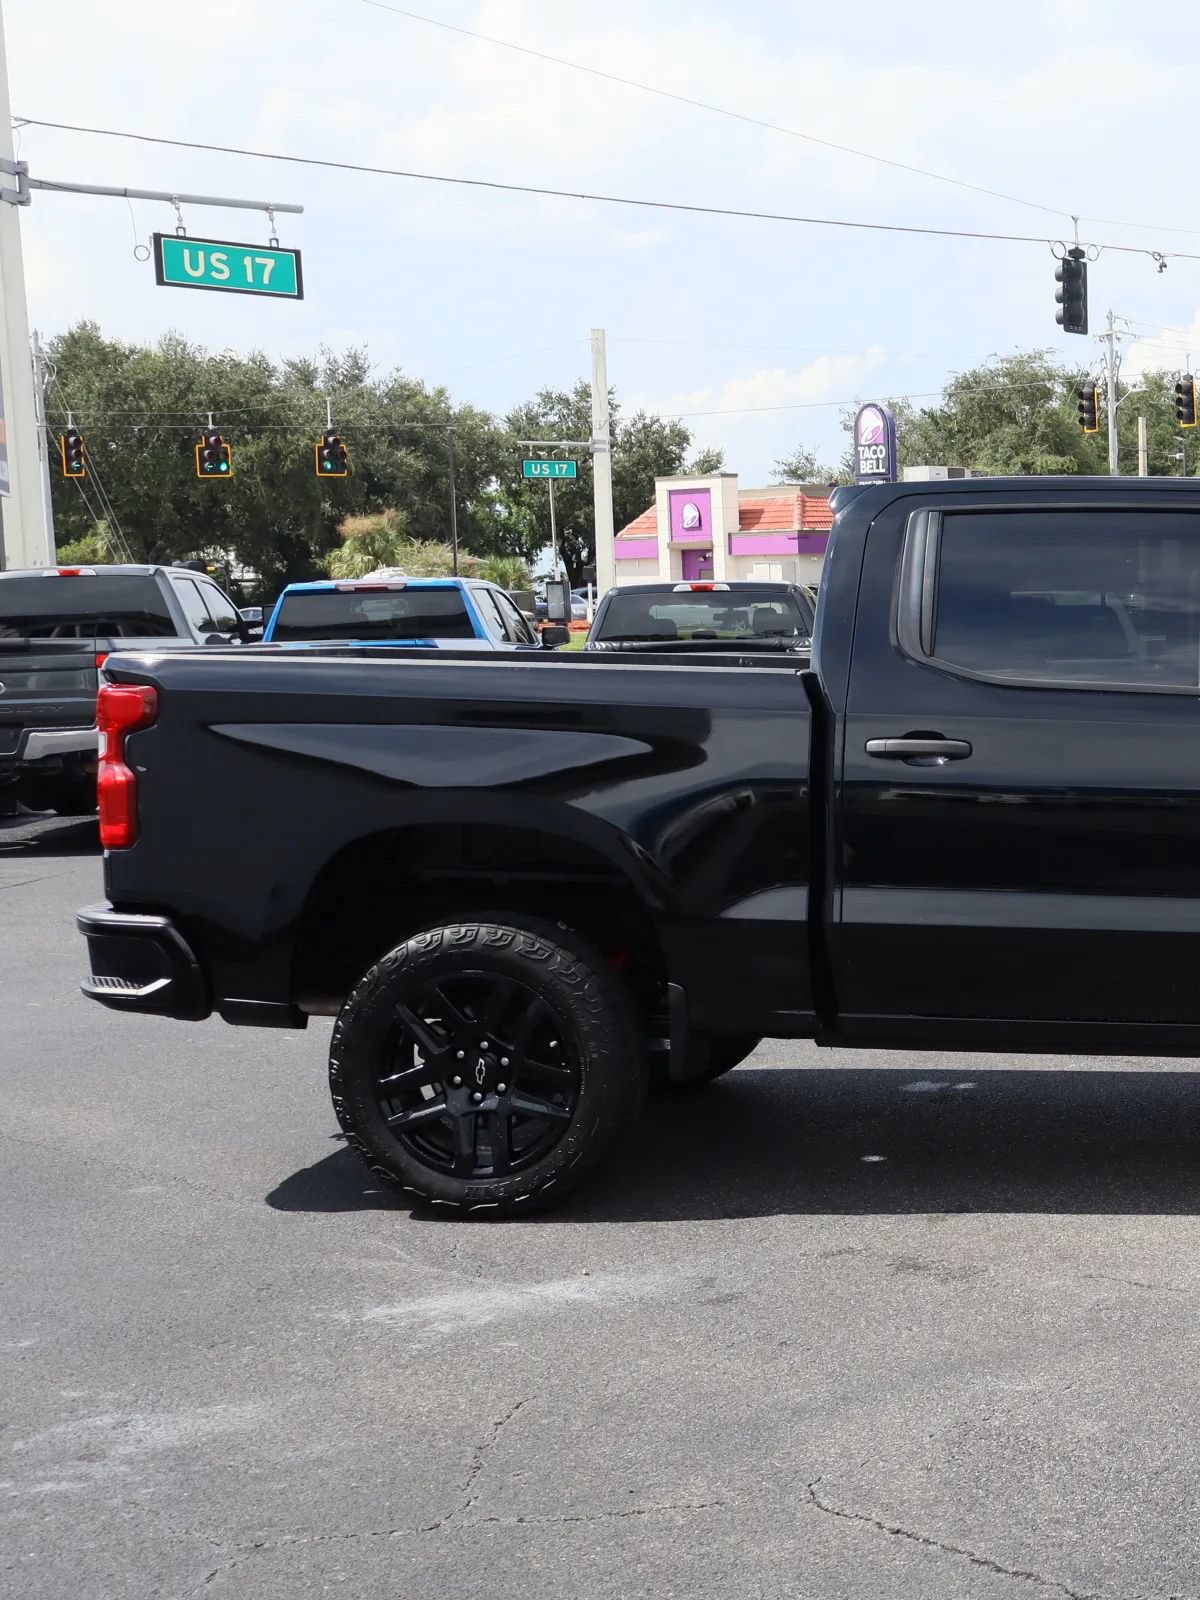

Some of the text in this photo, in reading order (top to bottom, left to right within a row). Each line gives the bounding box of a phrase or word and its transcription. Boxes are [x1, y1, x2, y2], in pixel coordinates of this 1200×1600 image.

[183, 248, 276, 285] US 17
[857, 444, 886, 460] TACO
[531, 463, 568, 475] US 17
[860, 459, 886, 474] BELL
